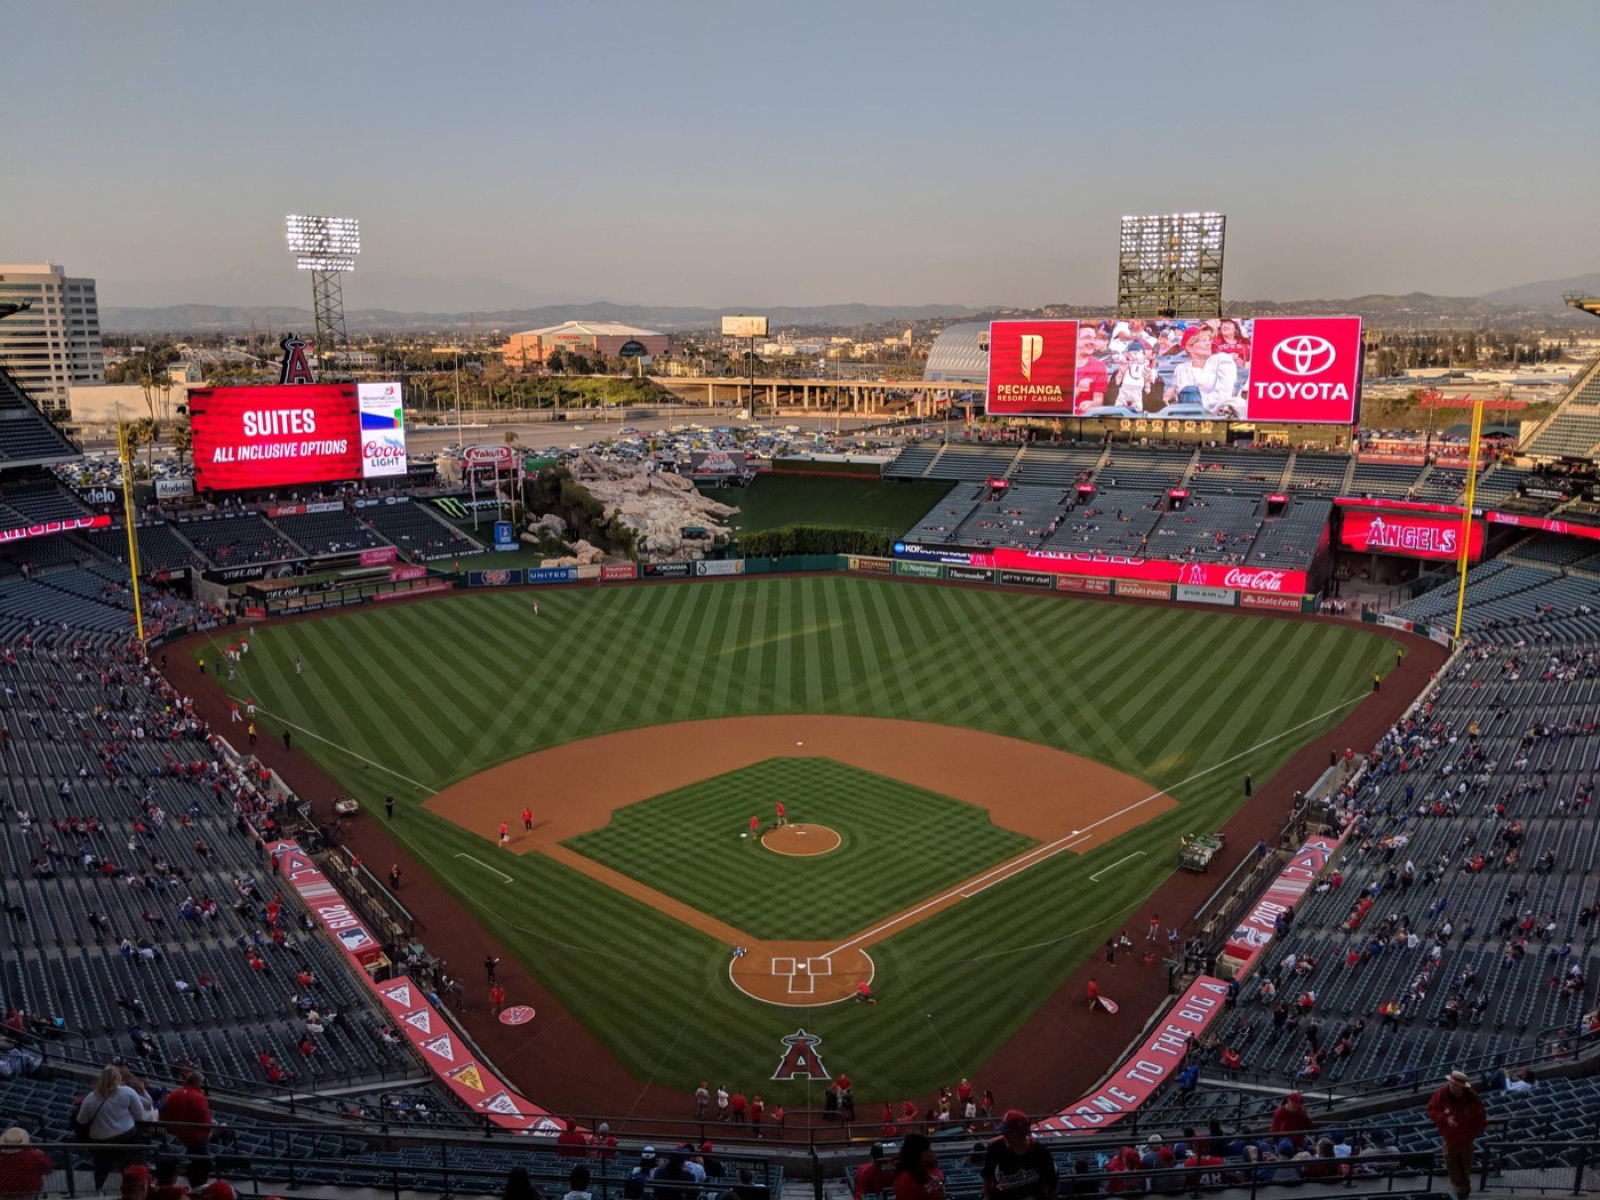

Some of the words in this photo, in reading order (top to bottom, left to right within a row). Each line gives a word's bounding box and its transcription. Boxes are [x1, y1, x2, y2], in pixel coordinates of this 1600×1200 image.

[997, 384, 1062, 394] PECHANGA
[1254, 382, 1349, 401] TOYOTA
[242, 408, 316, 436] SUITES
[213, 447, 235, 463] ALL
[238, 442, 298, 461] INCLUSIVE
[299, 439, 348, 457] OPTIONS
[363, 440, 405, 459] Coors
[473, 449, 505, 457] Yakult
[371, 457, 400, 467] LIGHT
[1365, 516, 1456, 553] ANGELS
[530, 571, 567, 579] UNITED
[655, 563, 688, 571] YOKOHAMA
[909, 563, 939, 573] National
[950, 570, 985, 580] Thermador
[1224, 568, 1286, 591] Coca-Cola
[317, 904, 358, 929] 2019
[1249, 901, 1287, 929] 2019
[1126, 1060, 1163, 1084] TO
[1151, 1024, 1192, 1056] THE
[1178, 994, 1217, 1023] BIG
[1200, 982, 1226, 994] A
